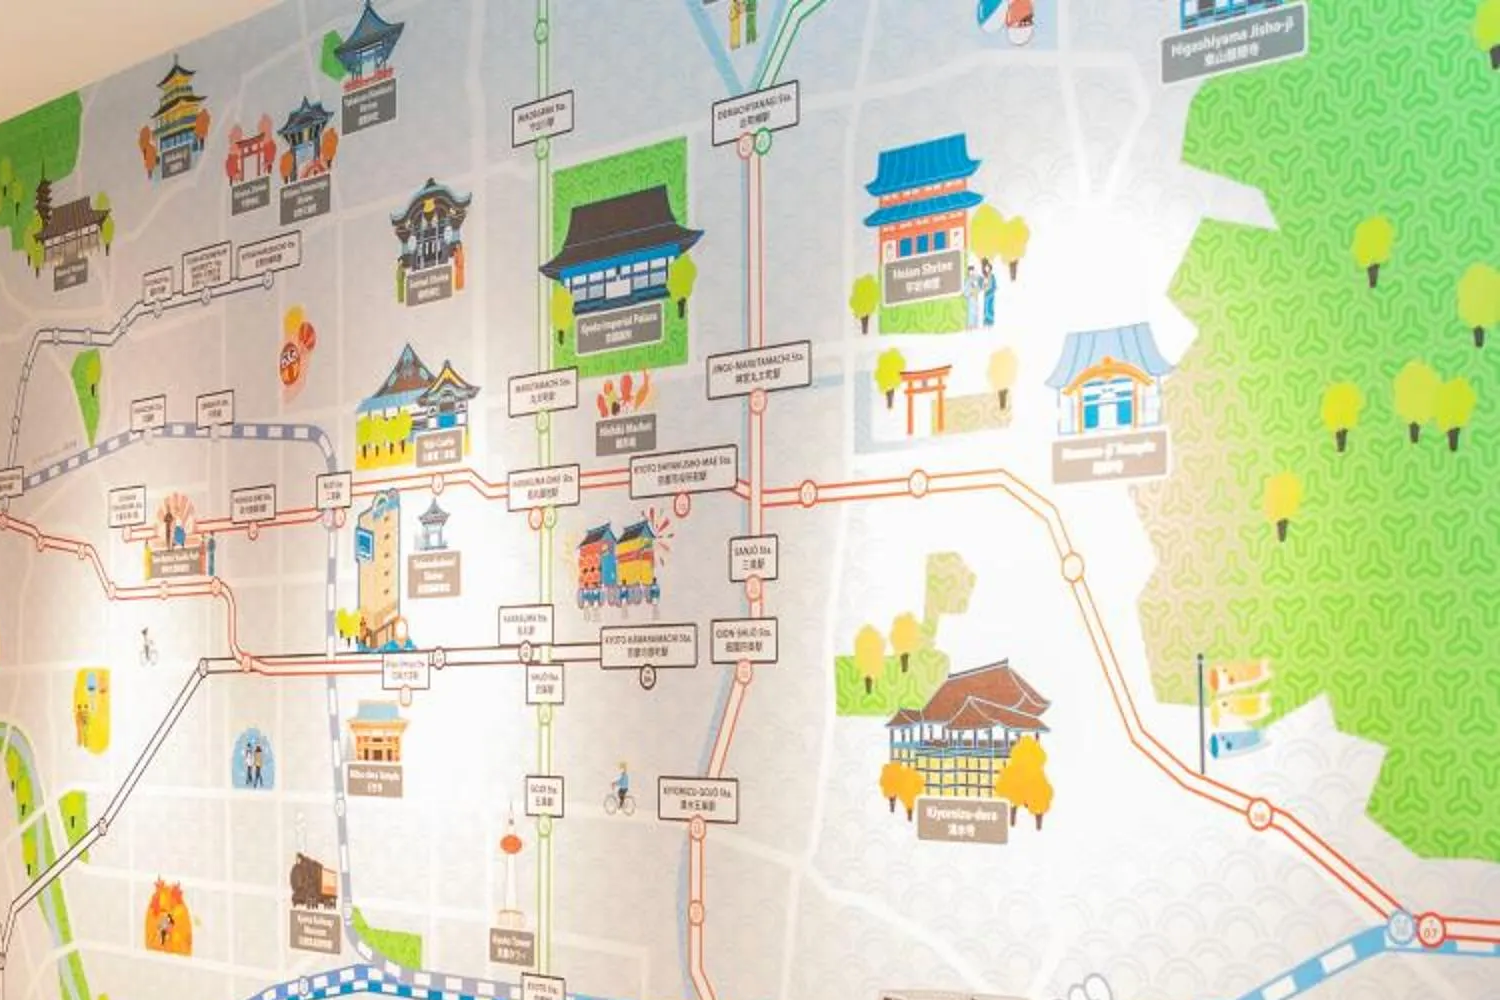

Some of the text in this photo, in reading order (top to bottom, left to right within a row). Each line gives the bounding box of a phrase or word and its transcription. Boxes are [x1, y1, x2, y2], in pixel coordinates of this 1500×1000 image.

[1171, 16, 1295, 58] Higashiyama Jisho-ji
[922, 261, 953, 276] Shrine
[926, 806, 998, 822] Kiyomizu-dera
[1423, 928, 1438, 940] 07
